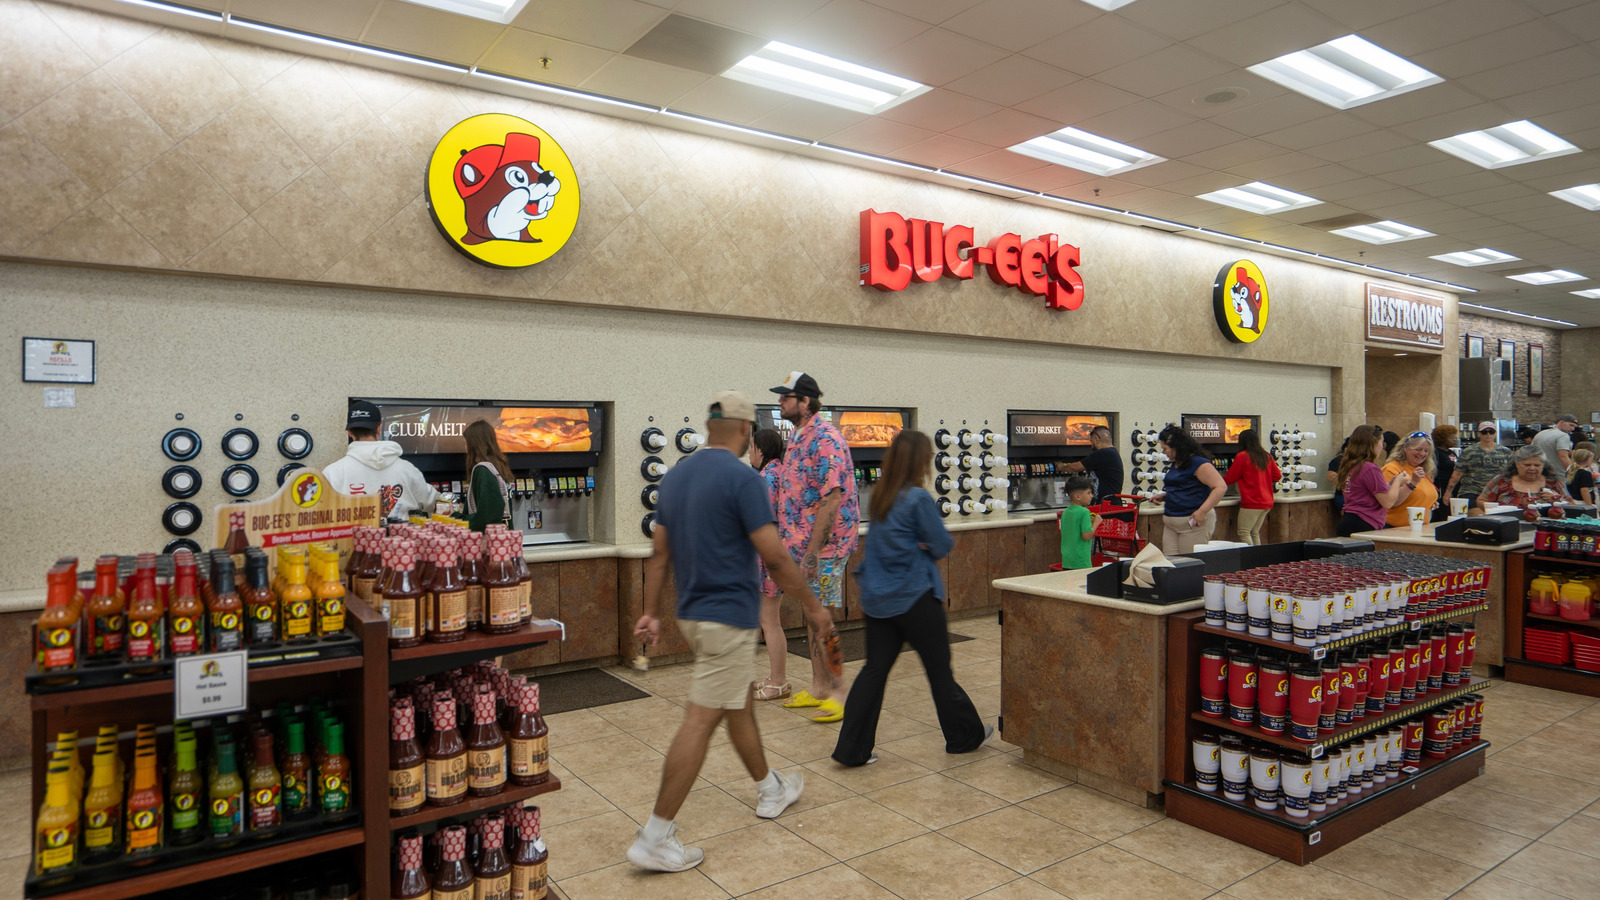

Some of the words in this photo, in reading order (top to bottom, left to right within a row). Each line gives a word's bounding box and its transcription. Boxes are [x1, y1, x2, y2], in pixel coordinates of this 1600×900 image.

[1371, 294, 1442, 334] RESTROOMS
[388, 422, 425, 438] CLUB
[430, 422, 466, 437] MELT
[1015, 425, 1036, 435] SLICED
[1037, 426, 1062, 435] BRISKET
[1190, 422, 1206, 430] SAUSAGE
[1190, 430, 1204, 438] CHEESE
[1204, 430, 1220, 438] BISCUITS
[297, 510, 334, 526] ORIGINAL
[336, 508, 351, 523] BBQ
[353, 505, 376, 521] SAUCE
[271, 534, 291, 544] Beaver
[292, 532, 311, 543] Tested,
[311, 530, 330, 540] Beaver
[480, 762, 501, 775] SAUCE
[441, 776, 454, 787] BBQ
[401, 782, 422, 796] SAUCE
